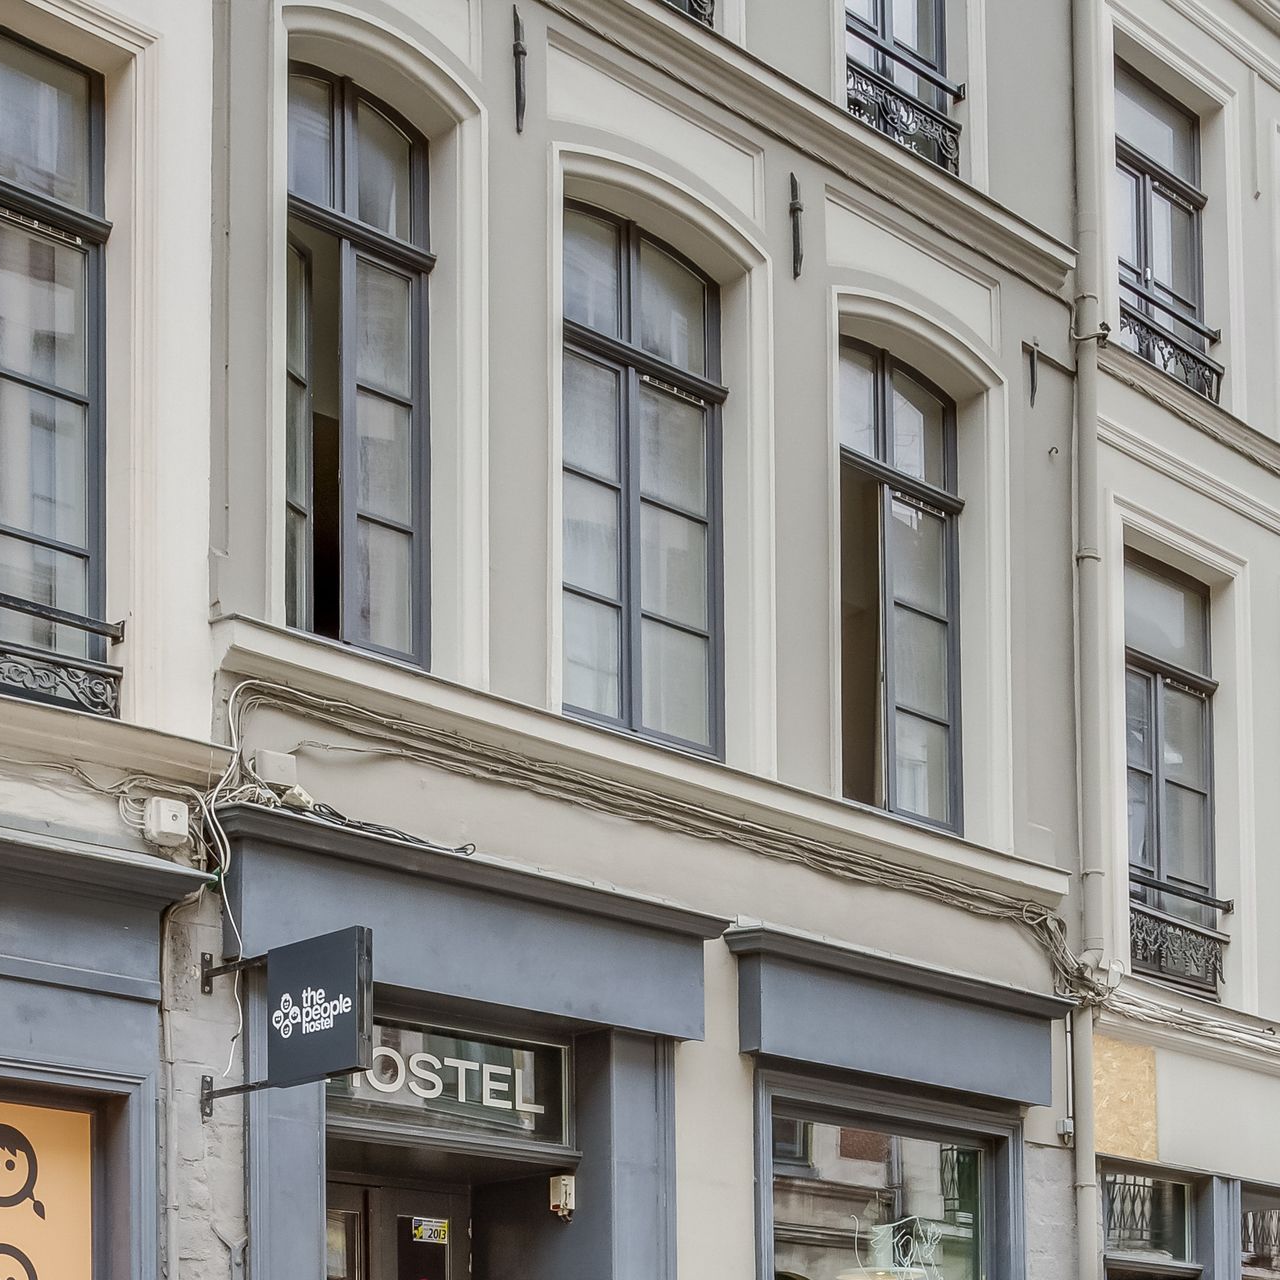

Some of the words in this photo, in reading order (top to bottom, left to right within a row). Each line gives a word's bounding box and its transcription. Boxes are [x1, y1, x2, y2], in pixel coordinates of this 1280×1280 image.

[301, 986, 326, 1008] the
[302, 993, 352, 1024] people
[302, 1015, 334, 1035] hostel
[325, 1046, 545, 1114] OSTEL
[427, 1227, 447, 1240] 2013
